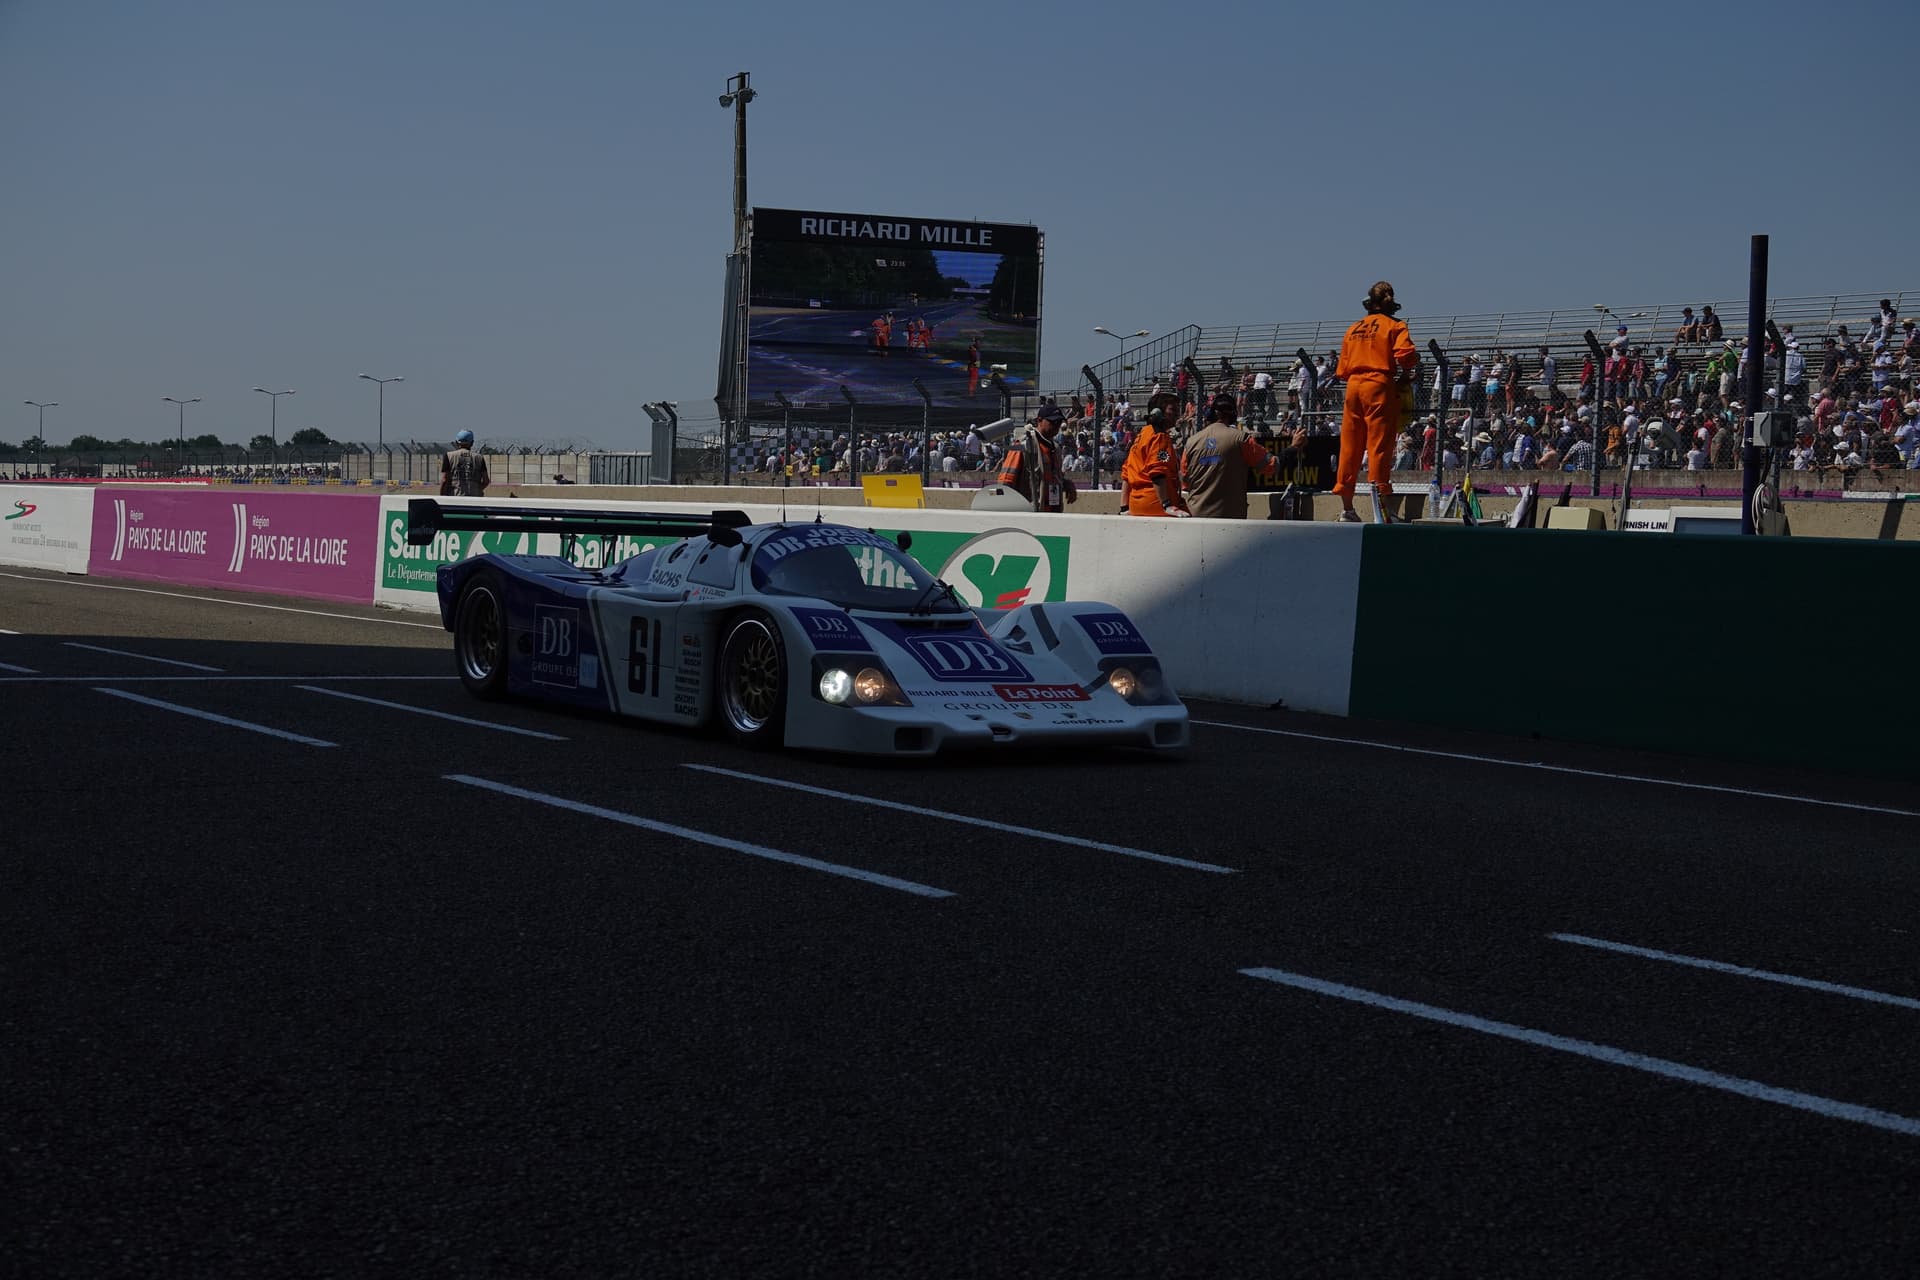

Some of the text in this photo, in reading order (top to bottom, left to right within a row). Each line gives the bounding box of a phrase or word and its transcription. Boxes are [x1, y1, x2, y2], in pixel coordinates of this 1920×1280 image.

[801, 217, 993, 247] RICHARD MILLE
[252, 514, 270, 530] Région
[128, 526, 208, 555] PAYS DE LA LOIRE
[250, 534, 349, 566] PAYS DE LA LOIRE
[760, 536, 807, 561] DB
[805, 535, 899, 554] RACING
[387, 562, 397, 579] Le
[651, 569, 682, 589] SACHS
[808, 615, 849, 633] DB
[1091, 621, 1130, 637] DB
[540, 615, 572, 657] DB
[628, 615, 661, 698] 61
[916, 639, 1010, 673] DB
[907, 689, 996, 698] RICHARD MILLE
[1002, 686, 1082, 700] Le Point
[943, 702, 1037, 711] GROUPE
